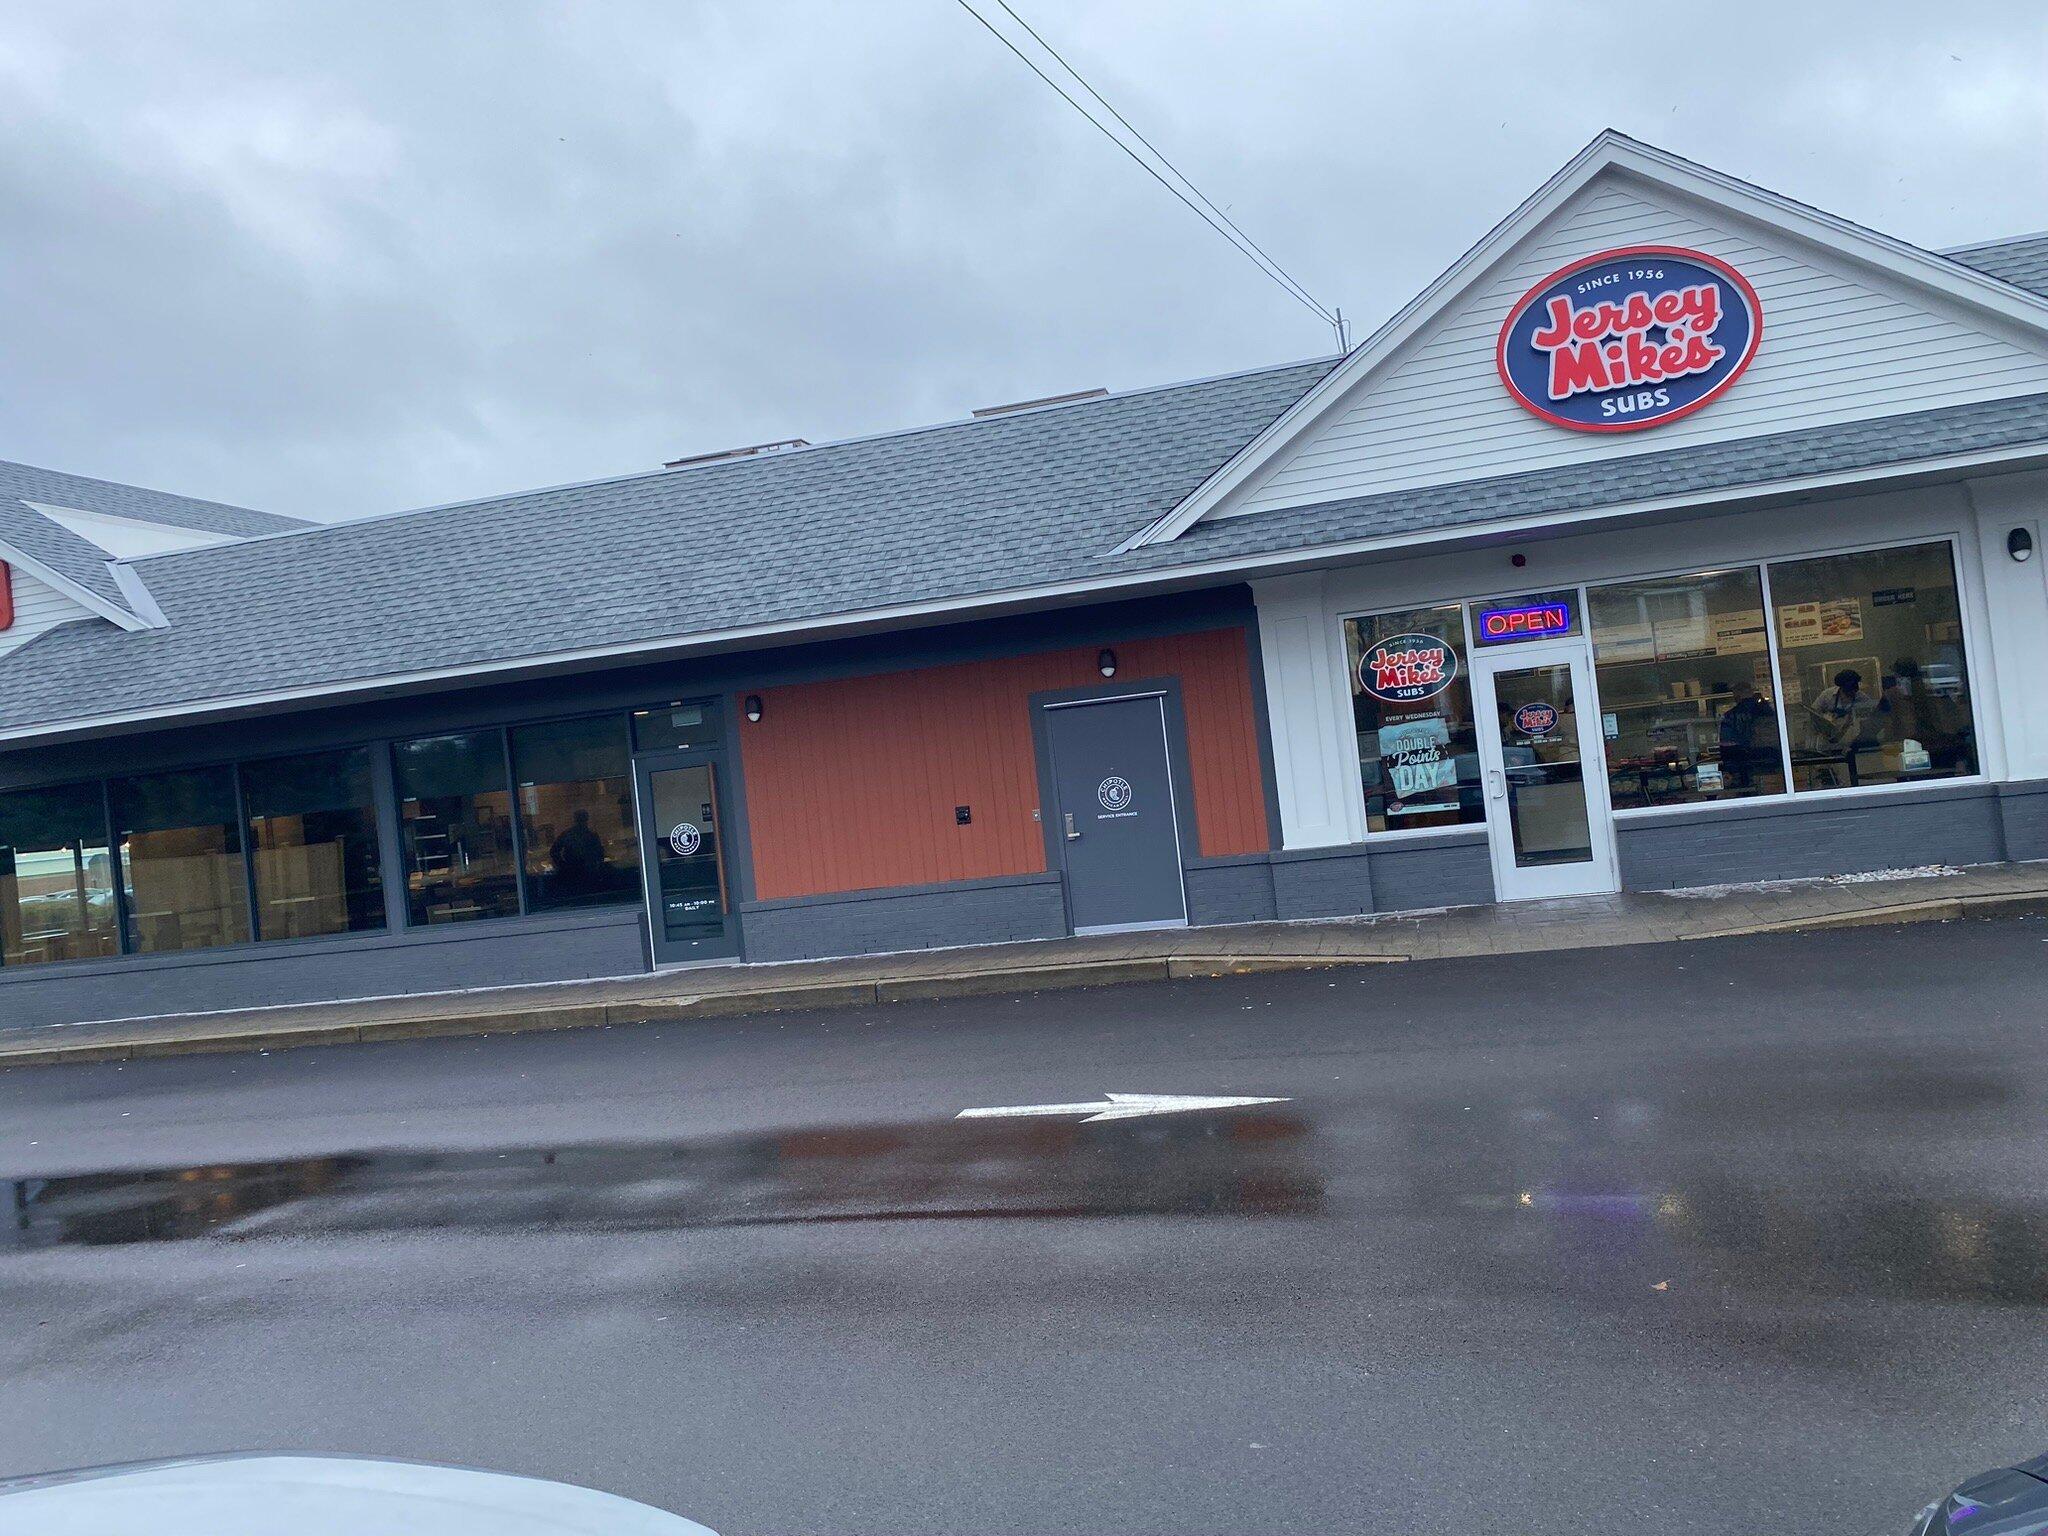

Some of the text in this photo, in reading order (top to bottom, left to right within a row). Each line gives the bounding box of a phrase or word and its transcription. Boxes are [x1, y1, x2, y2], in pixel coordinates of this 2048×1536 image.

[1577, 269, 1664, 294] SINCE 1956
[1533, 284, 1721, 349] Jersey
[1551, 328, 1723, 398] Mike's
[1600, 388, 1670, 417] SUBS
[1487, 608, 1563, 634] OPEN
[1370, 648, 1444, 670] Jersey
[1376, 664, 1445, 690] Mike's
[1396, 687, 1425, 698] SUBS
[1405, 711, 1441, 720] WEDNESDAY
[1396, 736, 1437, 752] DOUBLE
[1392, 748, 1441, 770] Points
[1100, 779, 1128, 793] CHIPOTLE
[1399, 762, 1440, 791] DAY
[672, 825, 697, 838] CHIPOTLE
